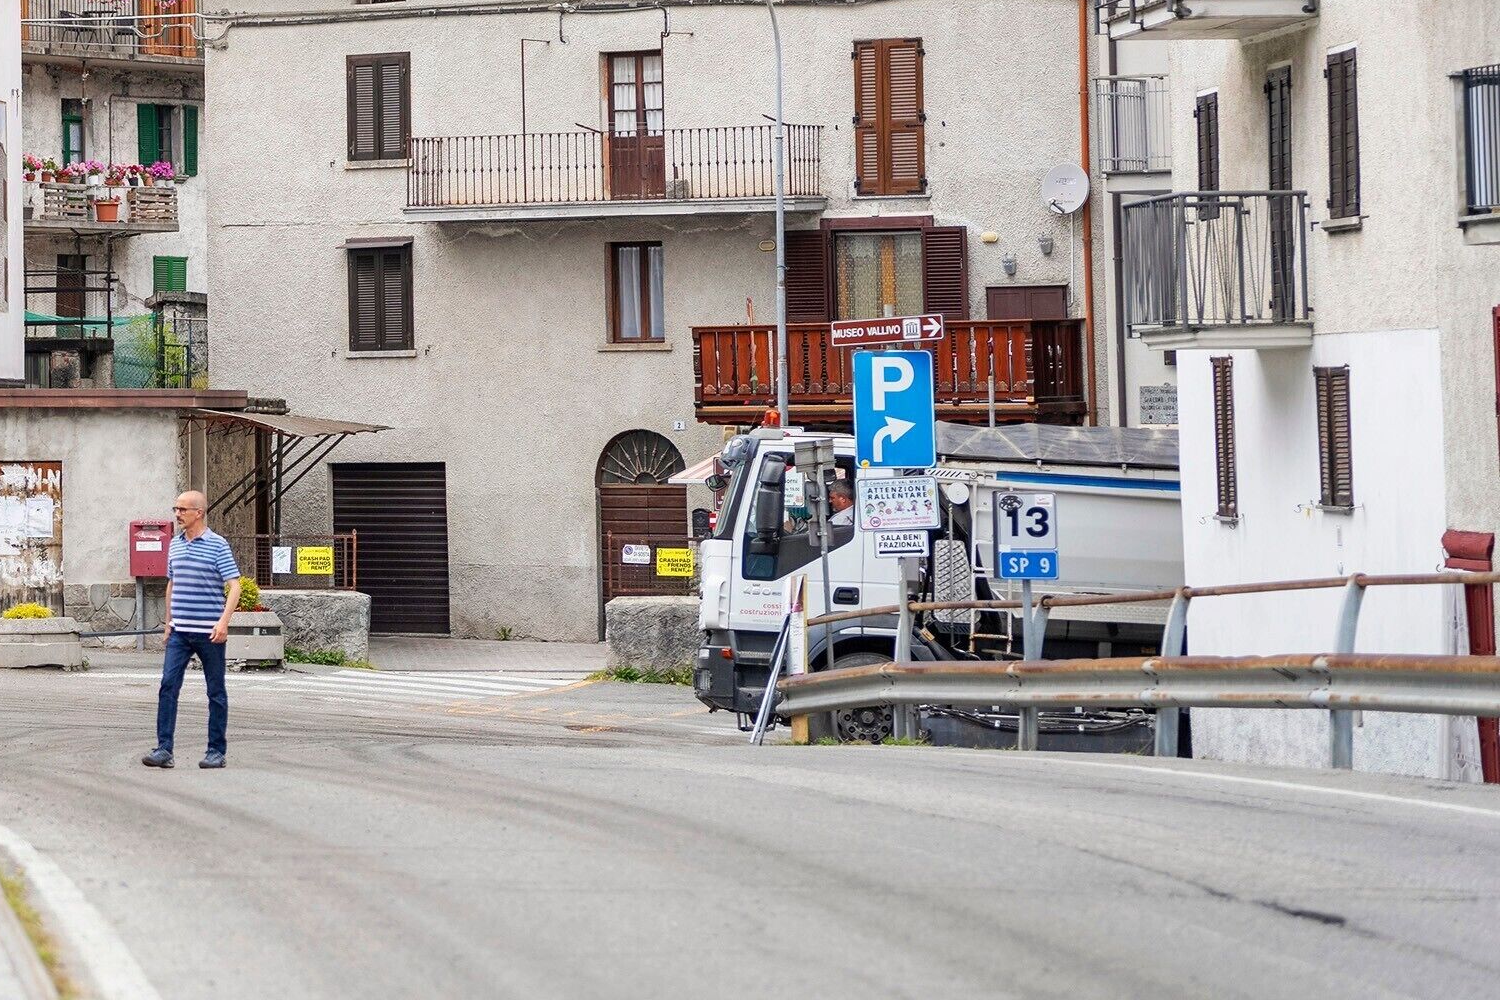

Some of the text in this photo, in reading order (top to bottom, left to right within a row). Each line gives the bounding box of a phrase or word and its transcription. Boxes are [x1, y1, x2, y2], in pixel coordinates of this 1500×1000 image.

[833, 325, 901, 338] MUSEO VALLIVO
[871, 356, 915, 411] P
[867, 485, 927, 494] ATTENZIONE
[867, 491, 928, 500] RALLENTARE
[1007, 504, 1049, 537] 13
[1009, 557, 1050, 573] SP 9
